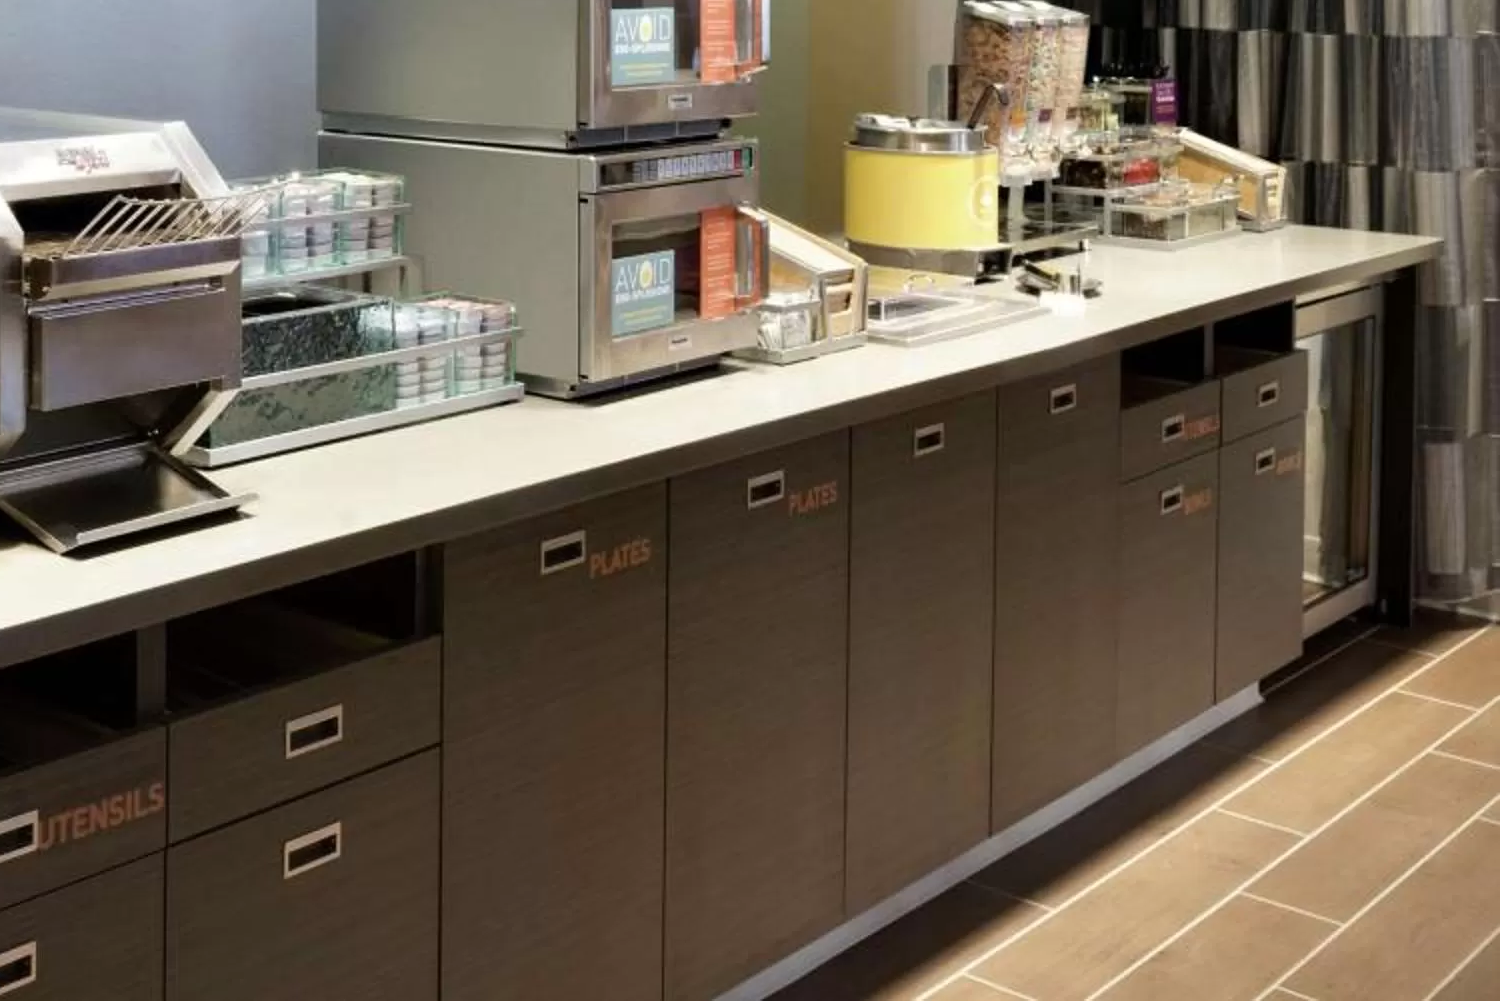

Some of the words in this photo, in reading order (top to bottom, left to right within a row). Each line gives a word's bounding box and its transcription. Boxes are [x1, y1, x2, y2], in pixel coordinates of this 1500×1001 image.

[787, 480, 838, 518] PLATES
[589, 538, 652, 579] PLATES
[37, 782, 165, 851] UTENSILS
